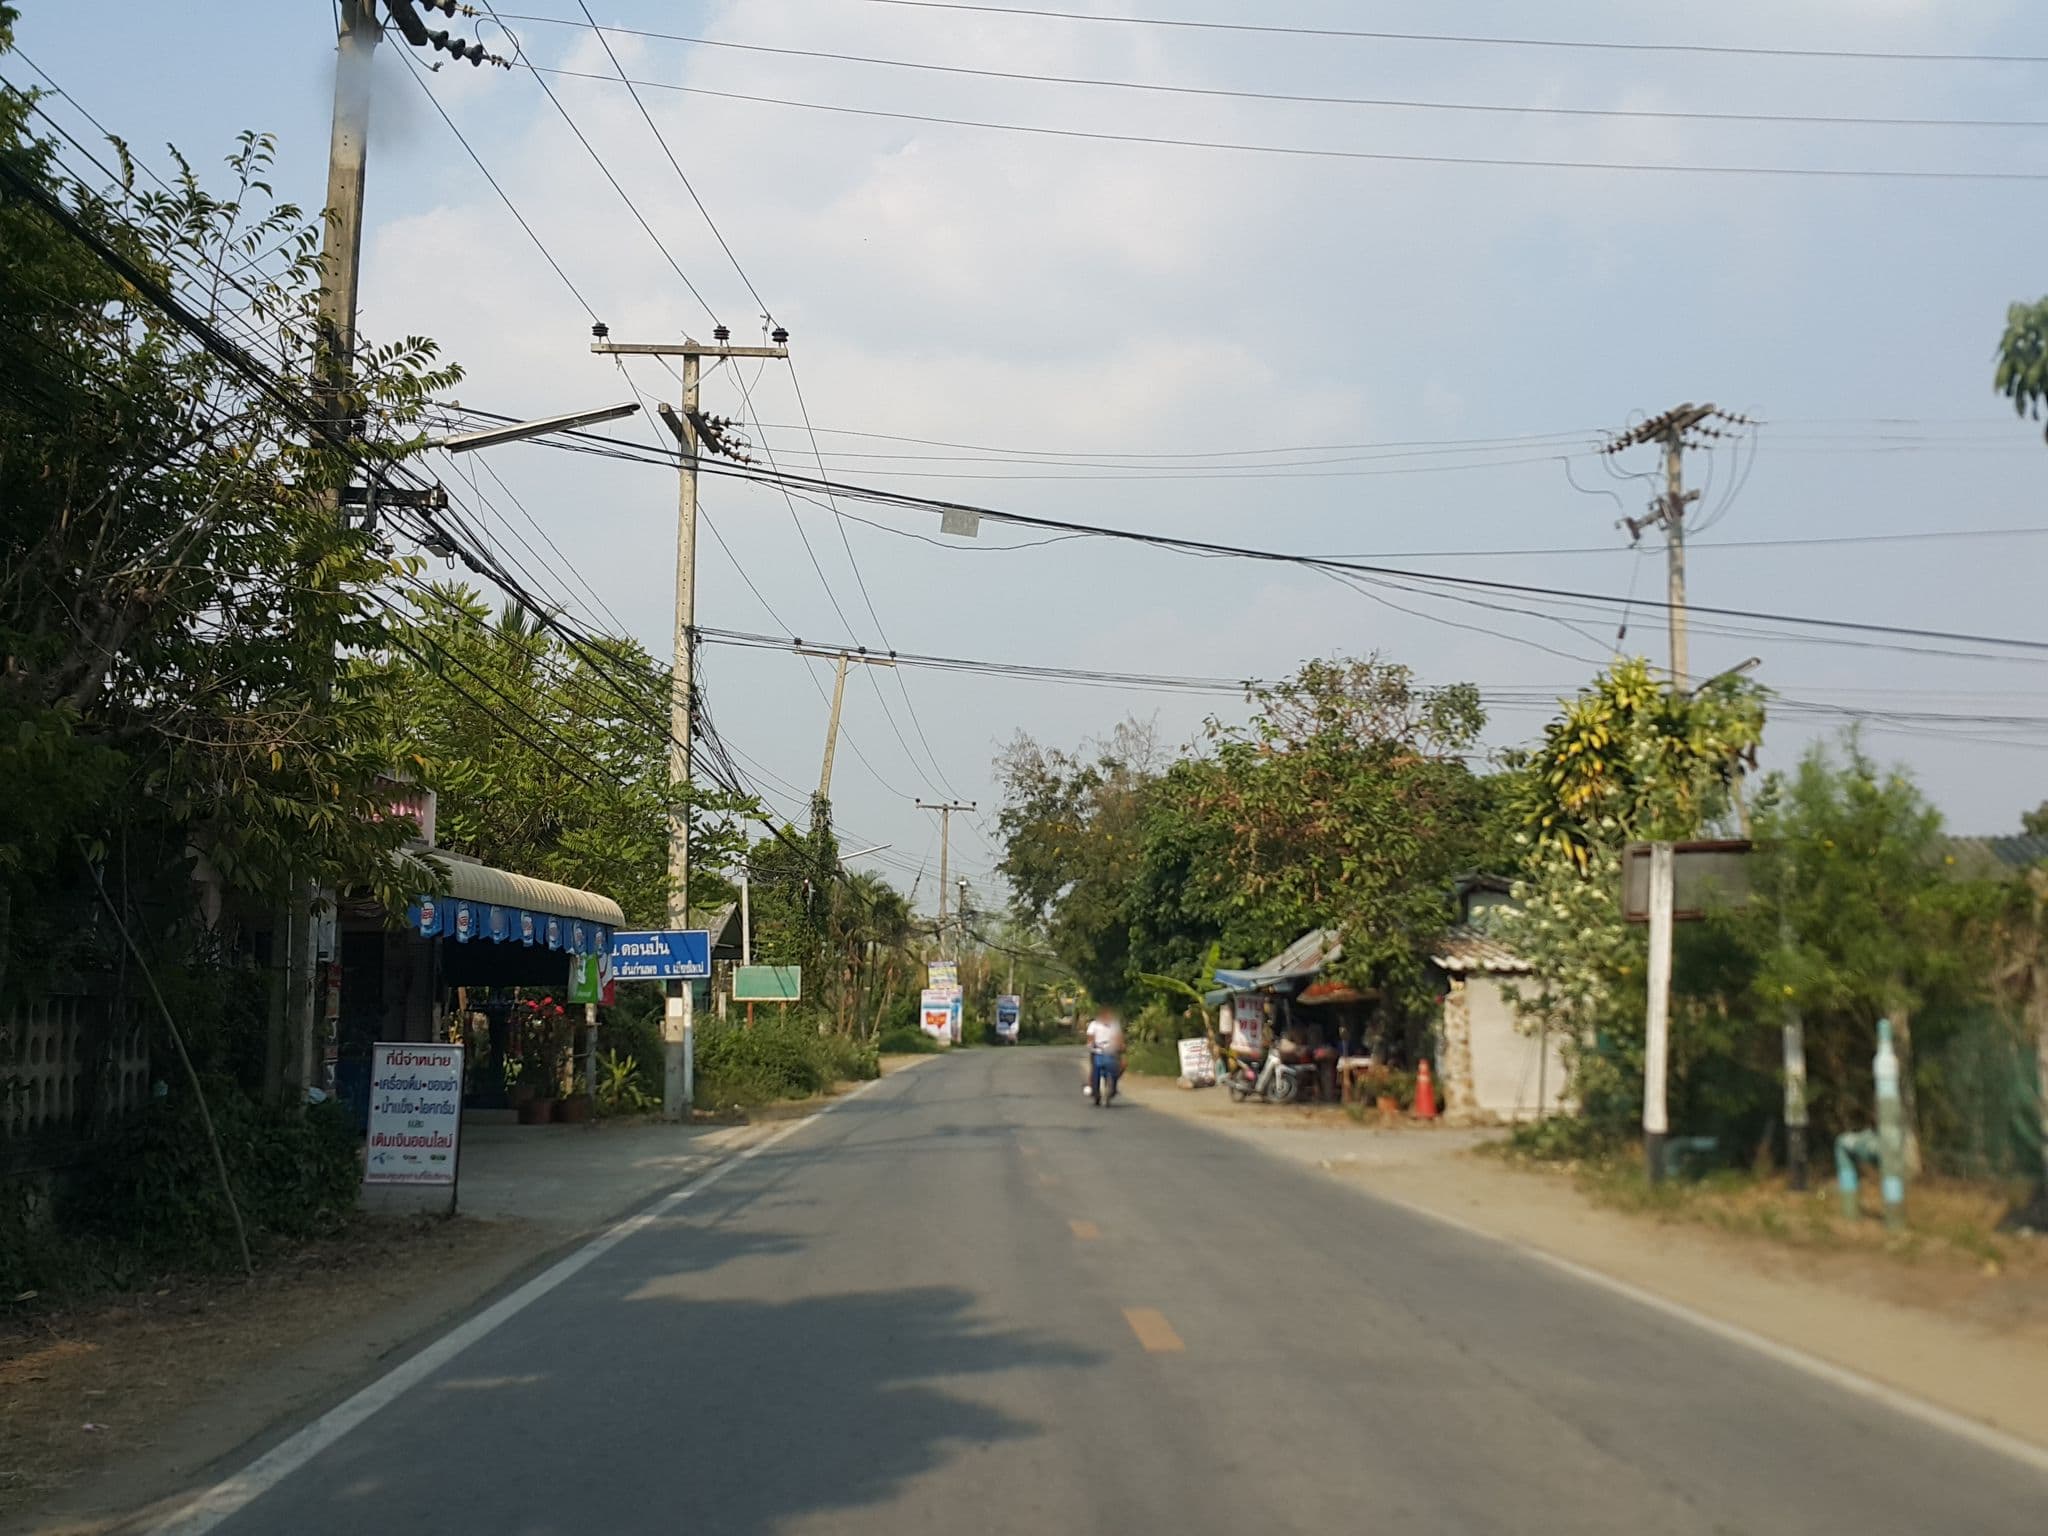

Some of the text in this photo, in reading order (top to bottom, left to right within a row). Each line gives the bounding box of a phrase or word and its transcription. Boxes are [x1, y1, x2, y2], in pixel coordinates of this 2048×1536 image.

[371, 1130, 454, 1148] เติมเงินออนไลน์
